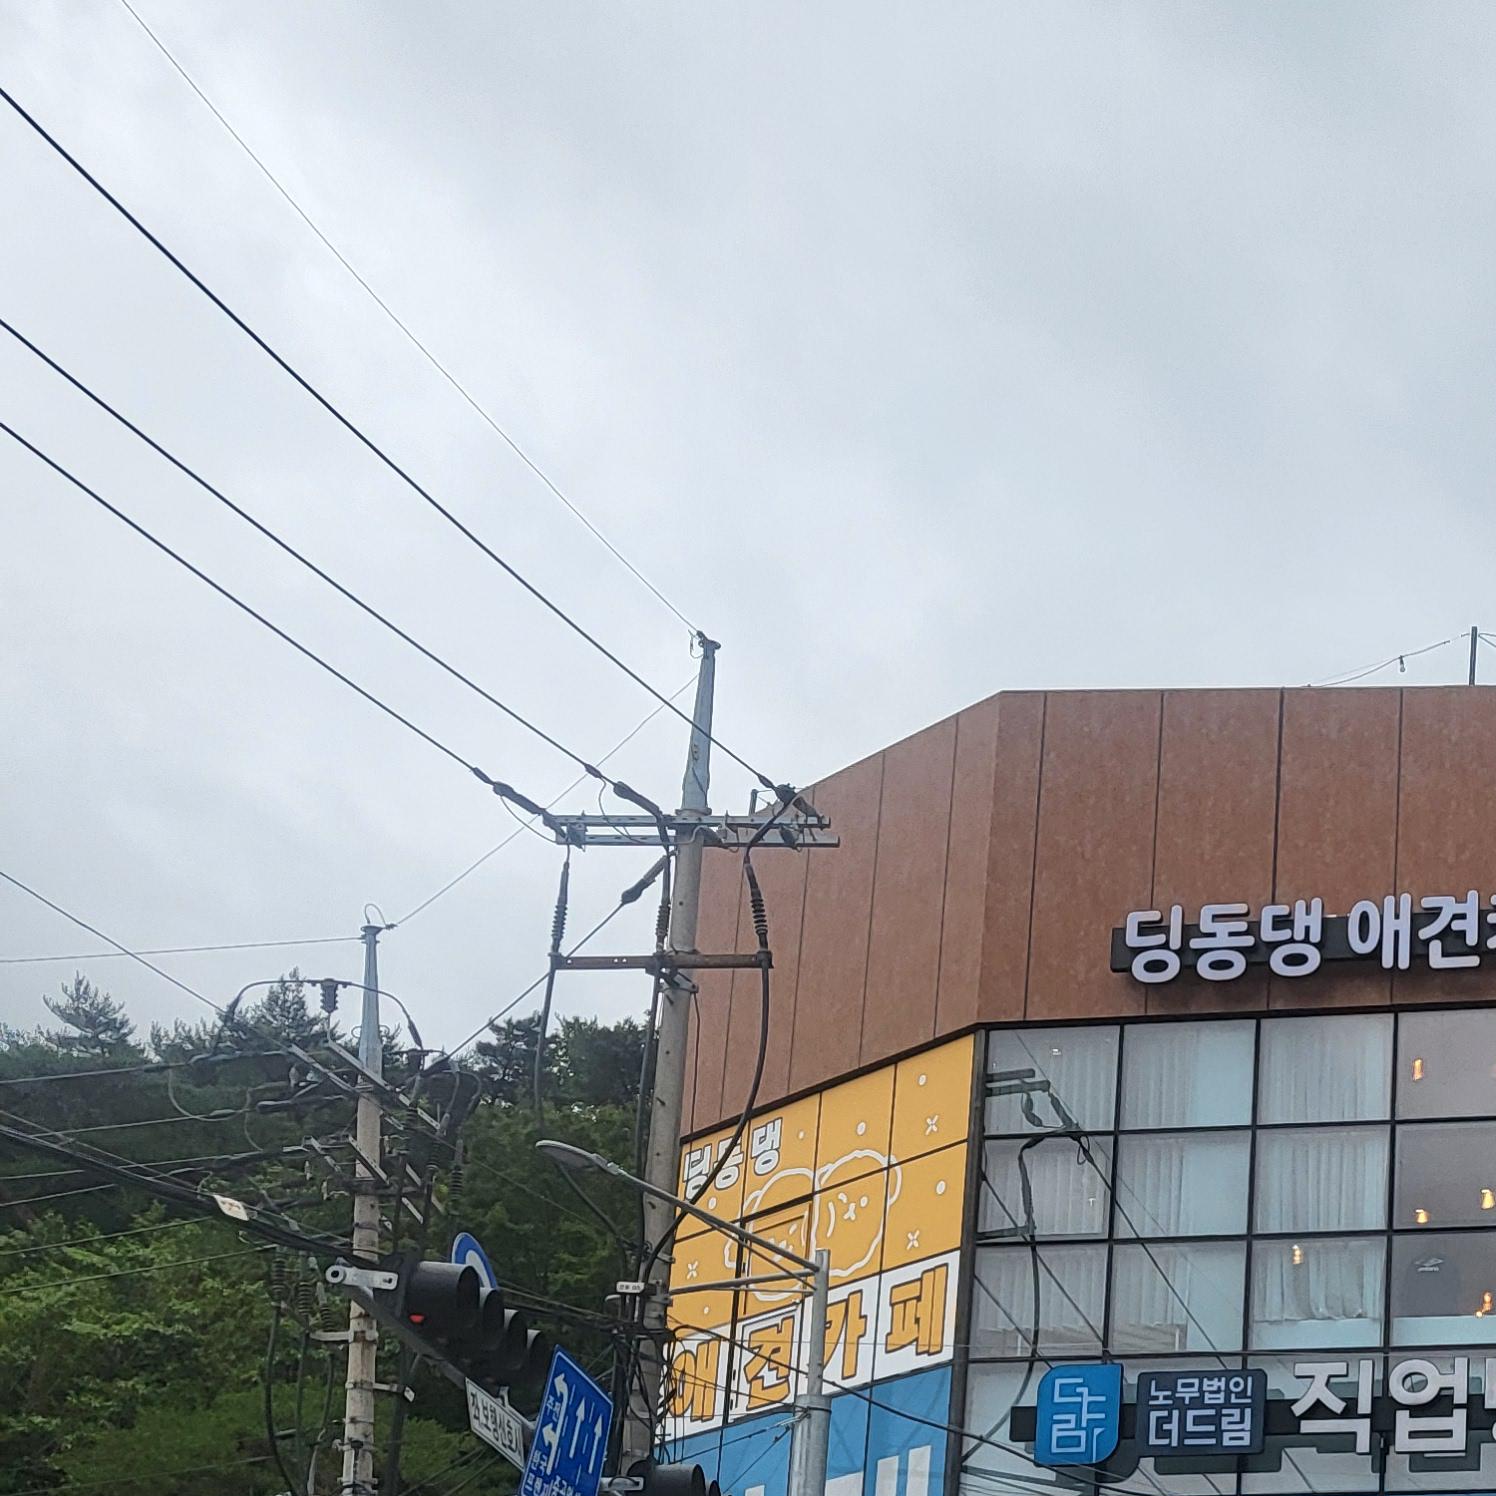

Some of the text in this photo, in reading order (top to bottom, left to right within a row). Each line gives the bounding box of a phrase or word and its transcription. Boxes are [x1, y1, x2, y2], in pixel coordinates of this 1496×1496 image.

[1125, 897, 1323, 984] 딩동댕
[684, 1117, 783, 1202] 딩동댕
[1149, 1376, 1253, 1405] 노무법인
[1149, 1407, 1252, 1447] 더드림
